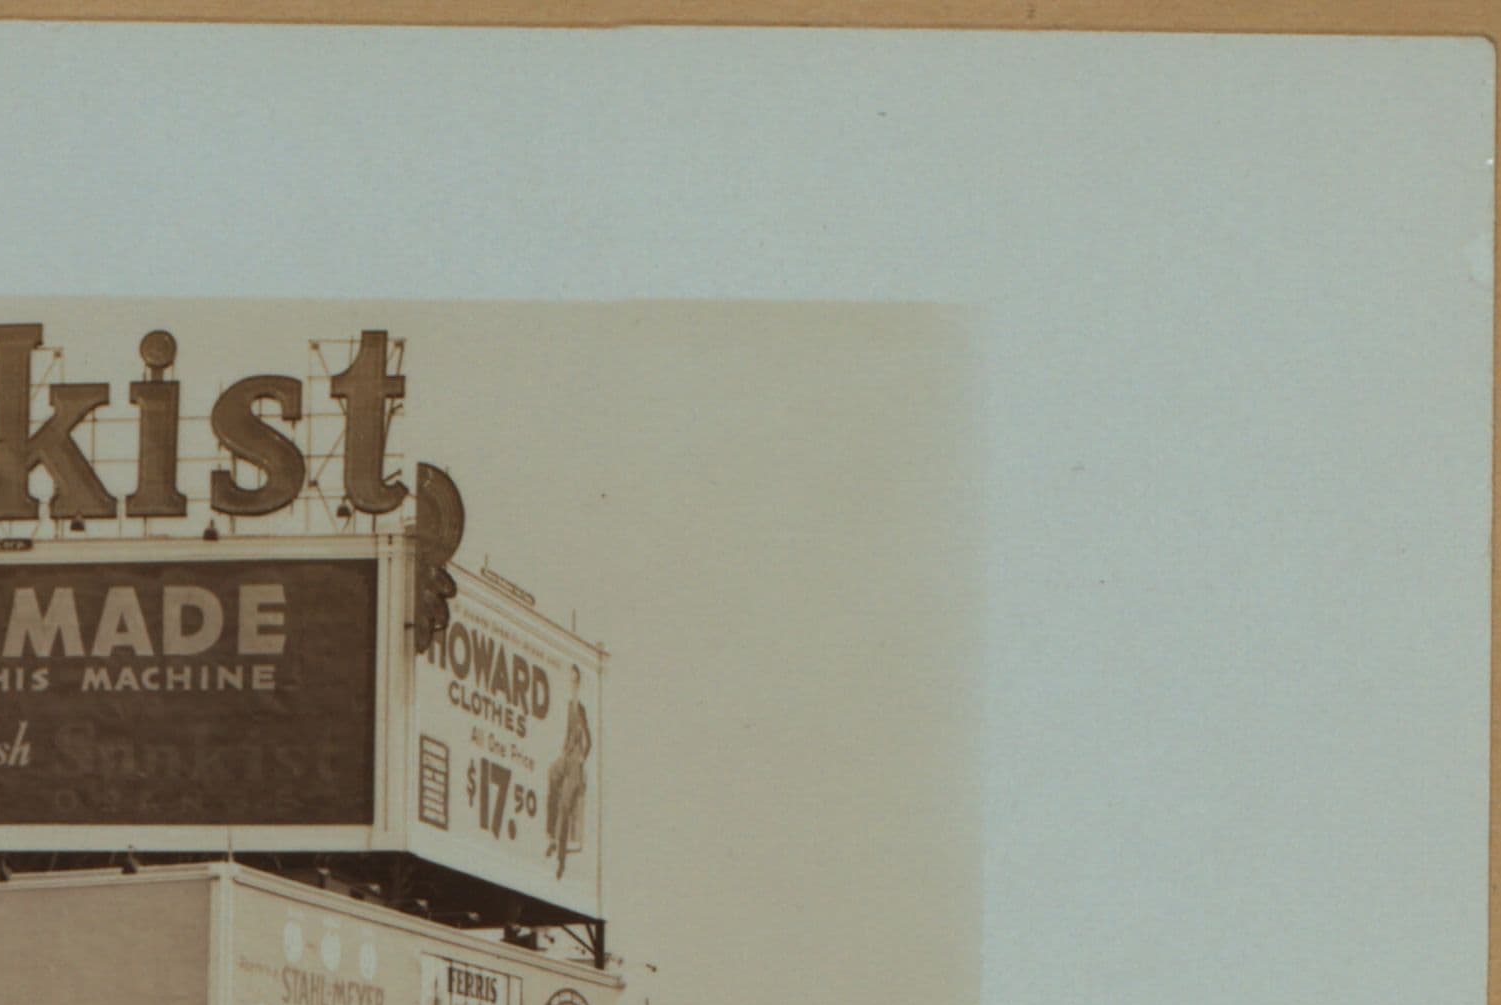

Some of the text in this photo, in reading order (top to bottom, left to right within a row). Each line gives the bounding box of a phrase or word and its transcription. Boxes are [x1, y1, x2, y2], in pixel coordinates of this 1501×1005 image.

[2, 584, 288, 657] MADE
[81, 664, 277, 690] MACHINE
[449, 680, 527, 739] CLOTHES
[447, 967, 498, 1004] FERRIS
